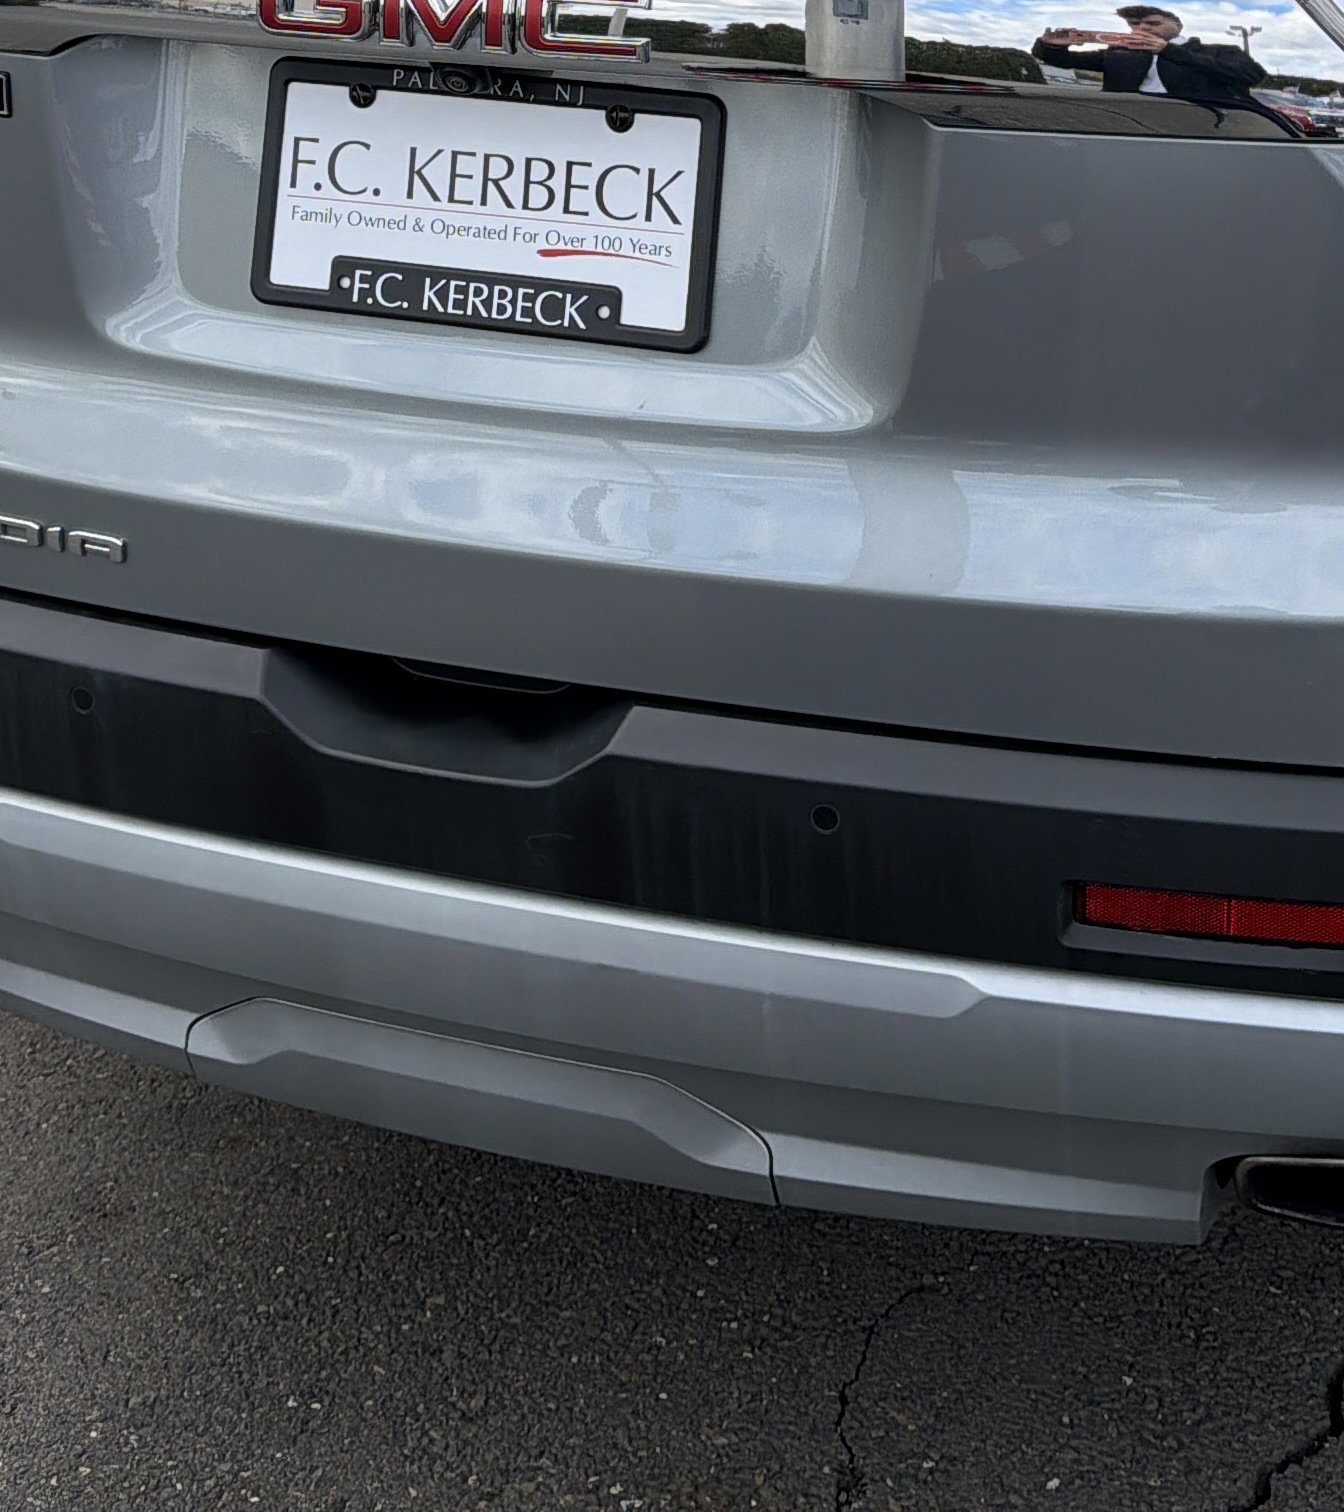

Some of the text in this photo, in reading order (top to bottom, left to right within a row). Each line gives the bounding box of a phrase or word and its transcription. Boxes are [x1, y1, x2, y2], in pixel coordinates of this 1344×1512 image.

[392, 68, 584, 106] PALRA, NJ
[289, 136, 685, 226] F.C. KERBECK
[291, 205, 673, 258] Family Owned & Operated For Over 100 Years
[352, 269, 590, 330] F.C. KERBECK
